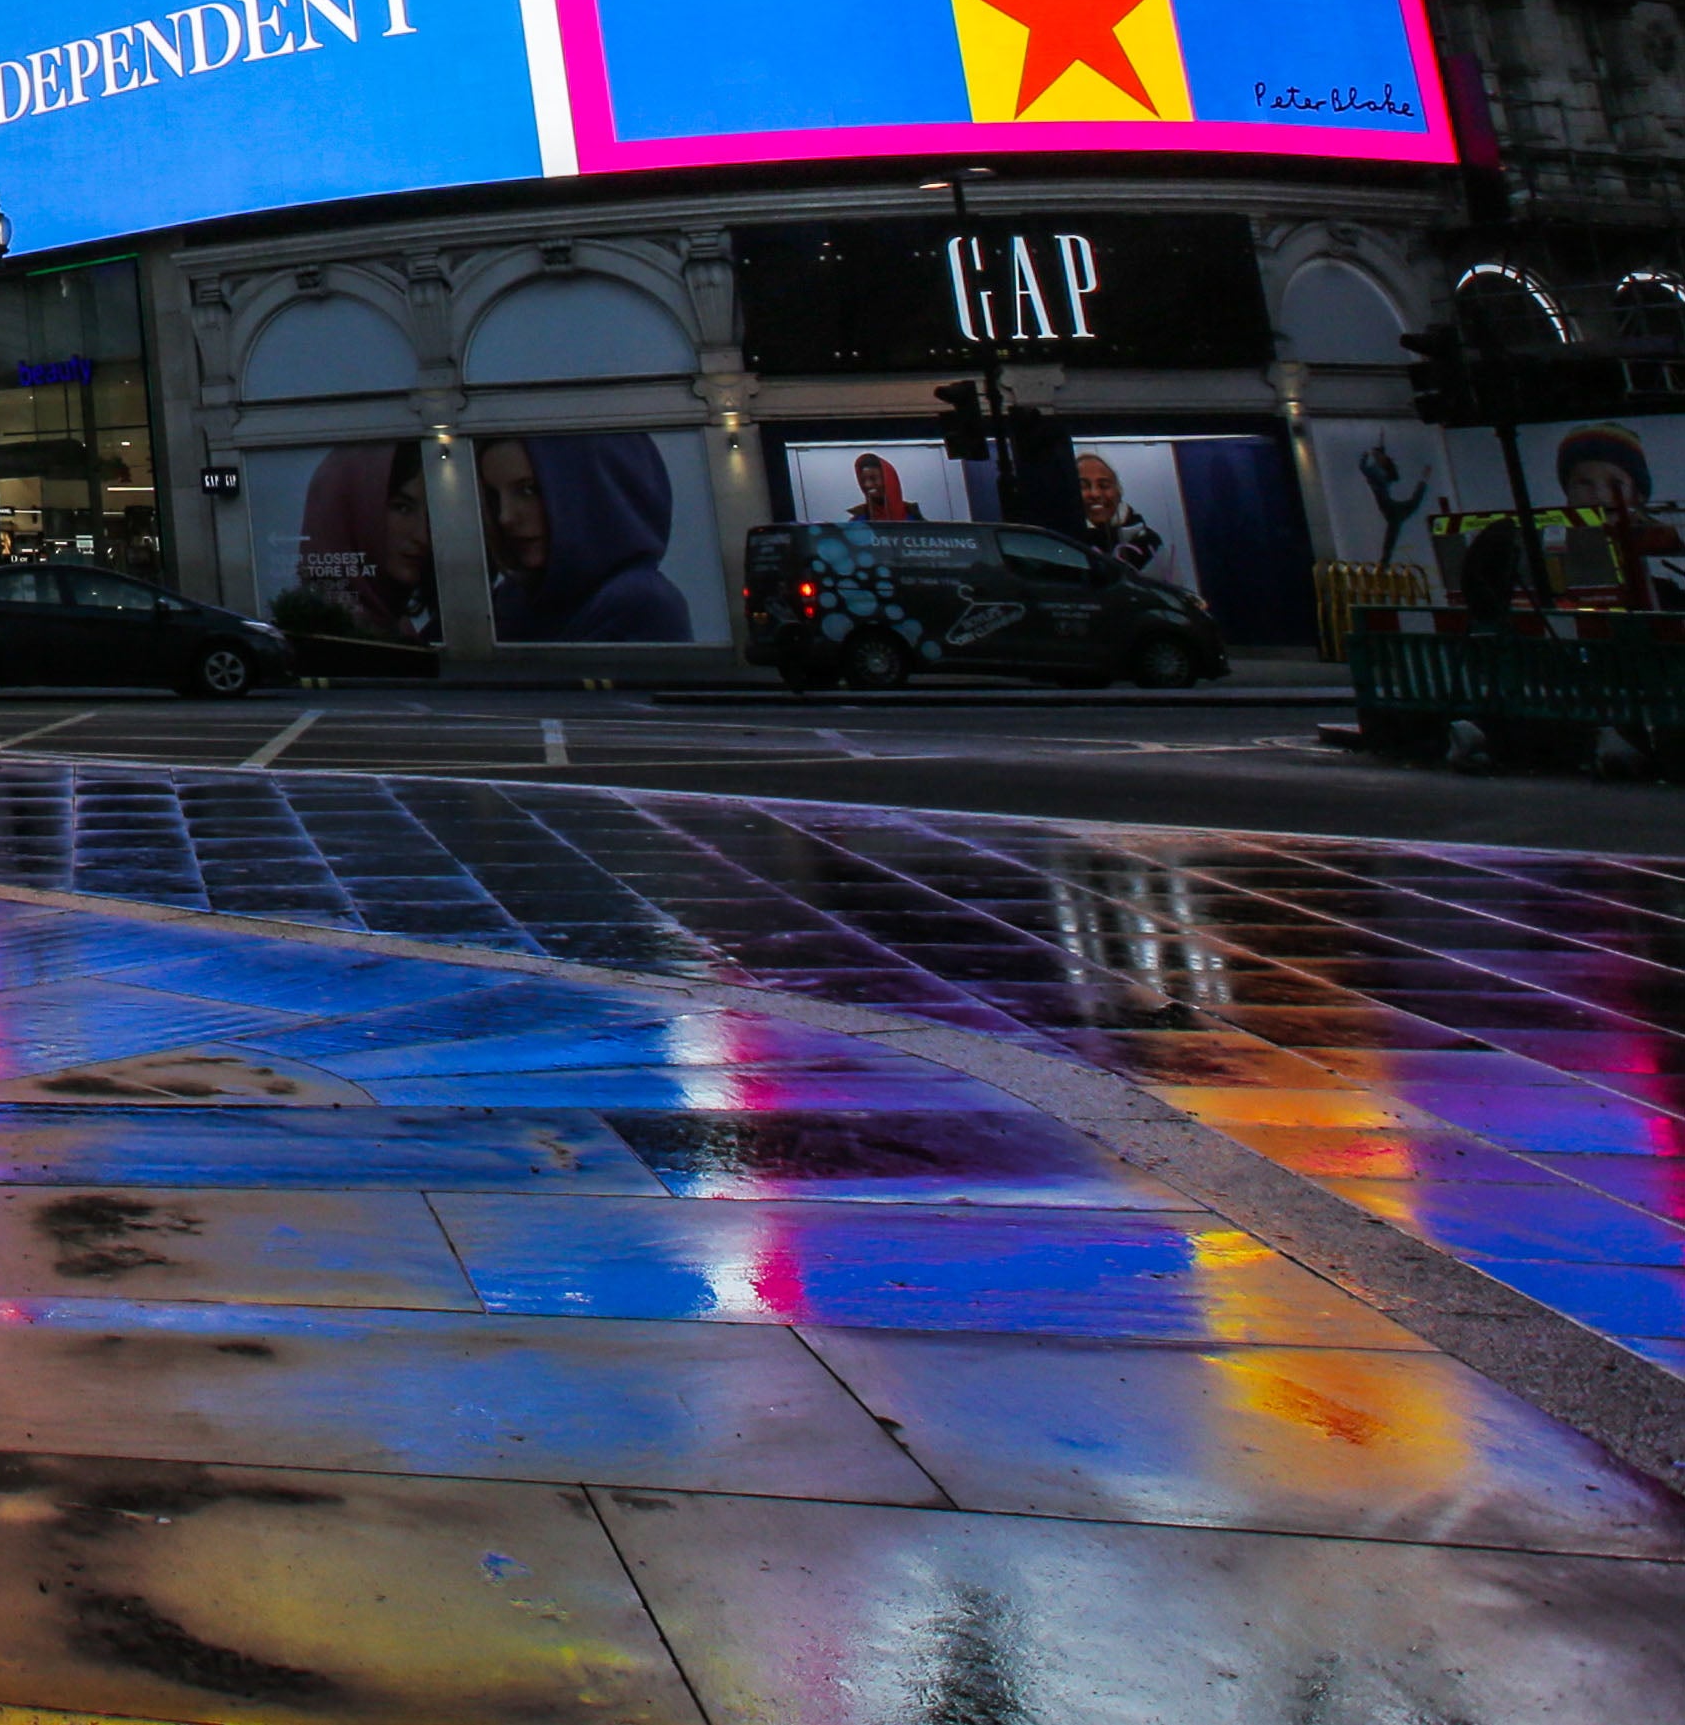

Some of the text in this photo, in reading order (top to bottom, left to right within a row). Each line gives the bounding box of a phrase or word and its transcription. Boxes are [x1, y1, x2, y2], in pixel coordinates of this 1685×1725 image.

[1254, 82, 1414, 116] Peter Blake
[947, 234, 1100, 342] GAP
[18, 354, 94, 387] beauty
[902, 536, 977, 549] CLEANING
[307, 551, 367, 565] CLOSEST
[360, 563, 378, 578] AT
